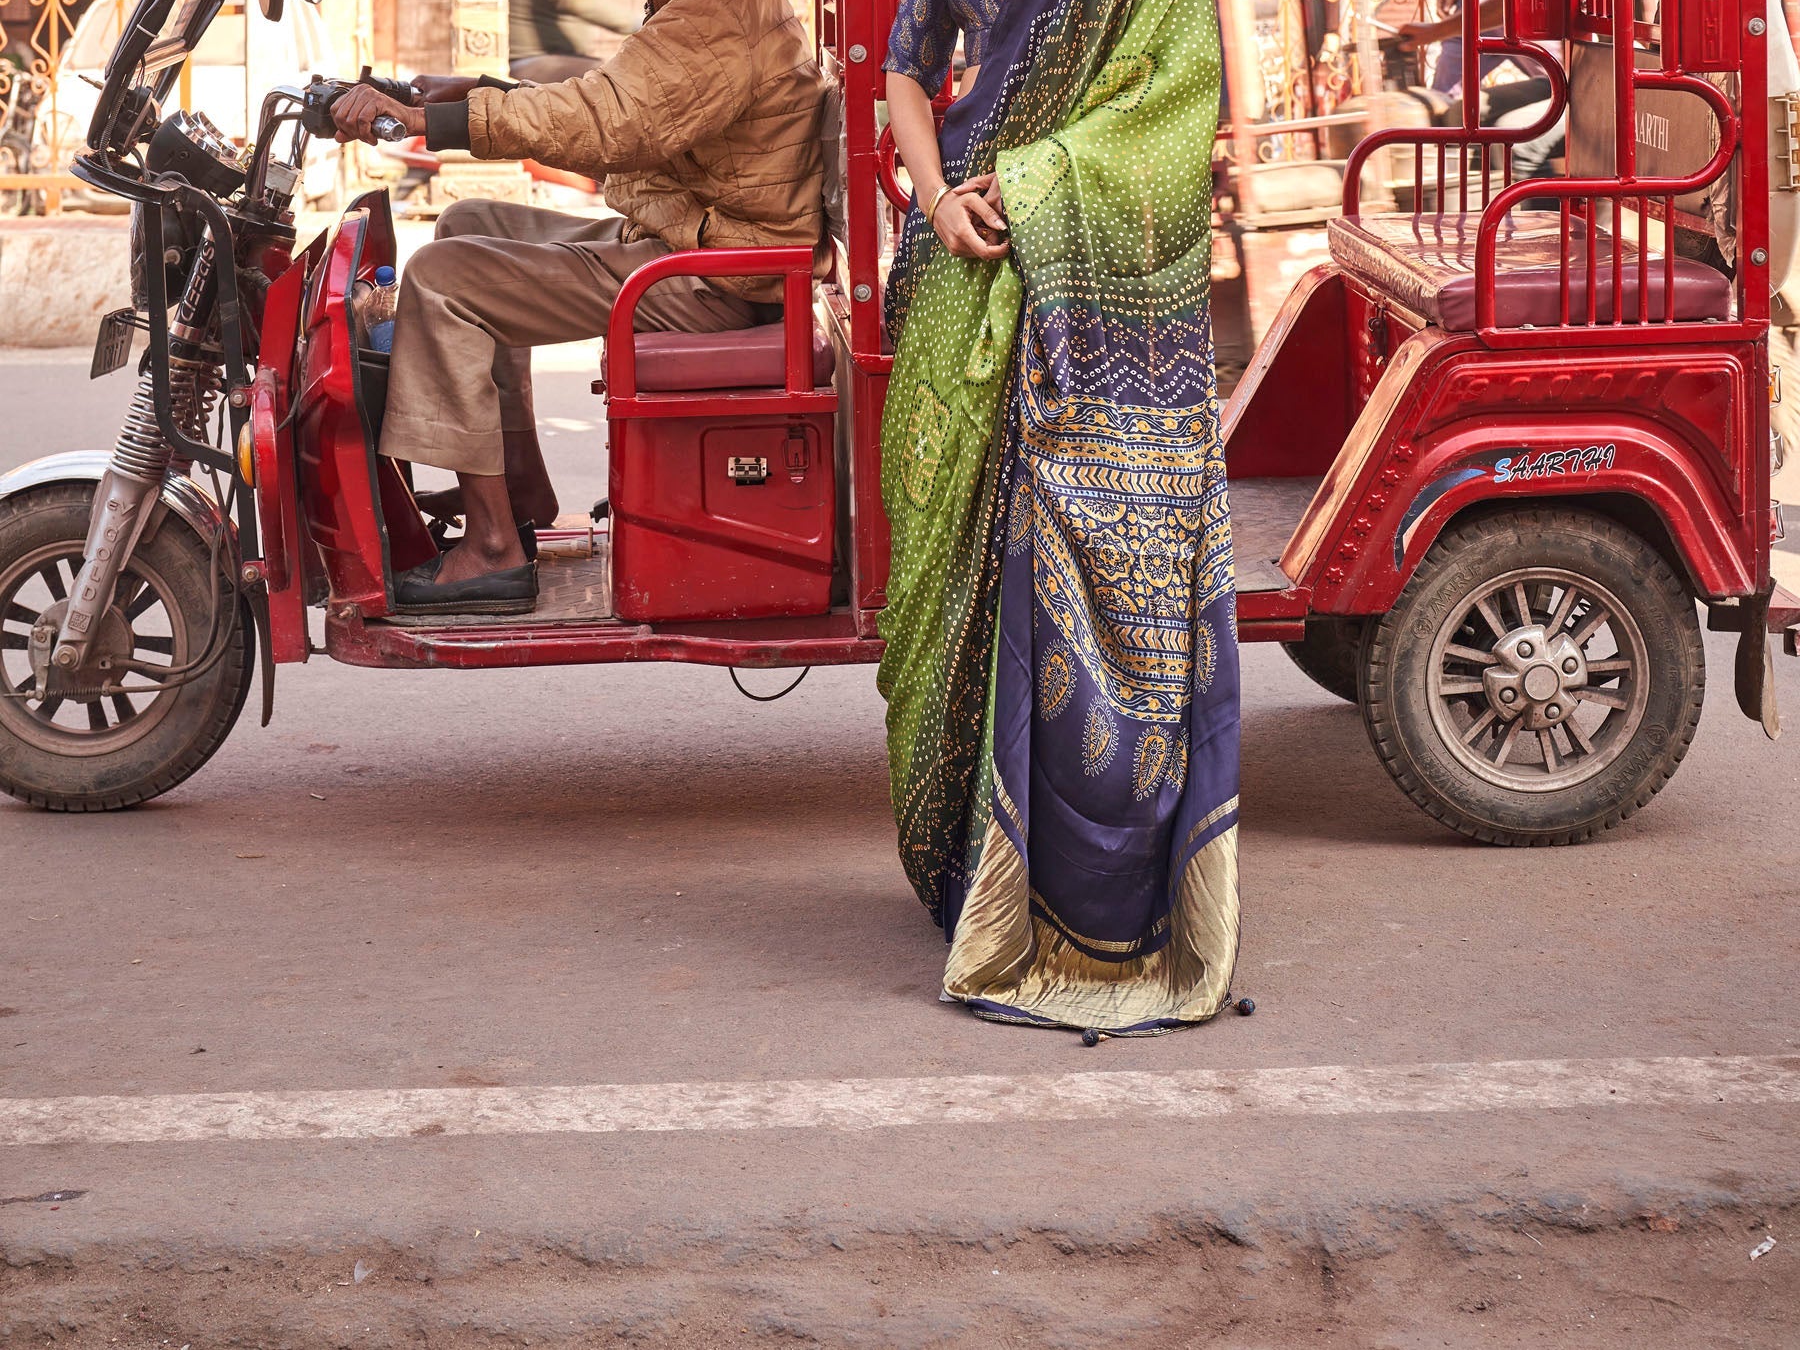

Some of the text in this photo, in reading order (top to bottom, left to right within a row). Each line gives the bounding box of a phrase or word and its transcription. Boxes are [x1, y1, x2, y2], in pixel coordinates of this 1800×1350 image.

[180, 241, 215, 321] SPEED
[1493, 444, 1616, 484] SAARTHI
[82, 528, 118, 601] GOLD
